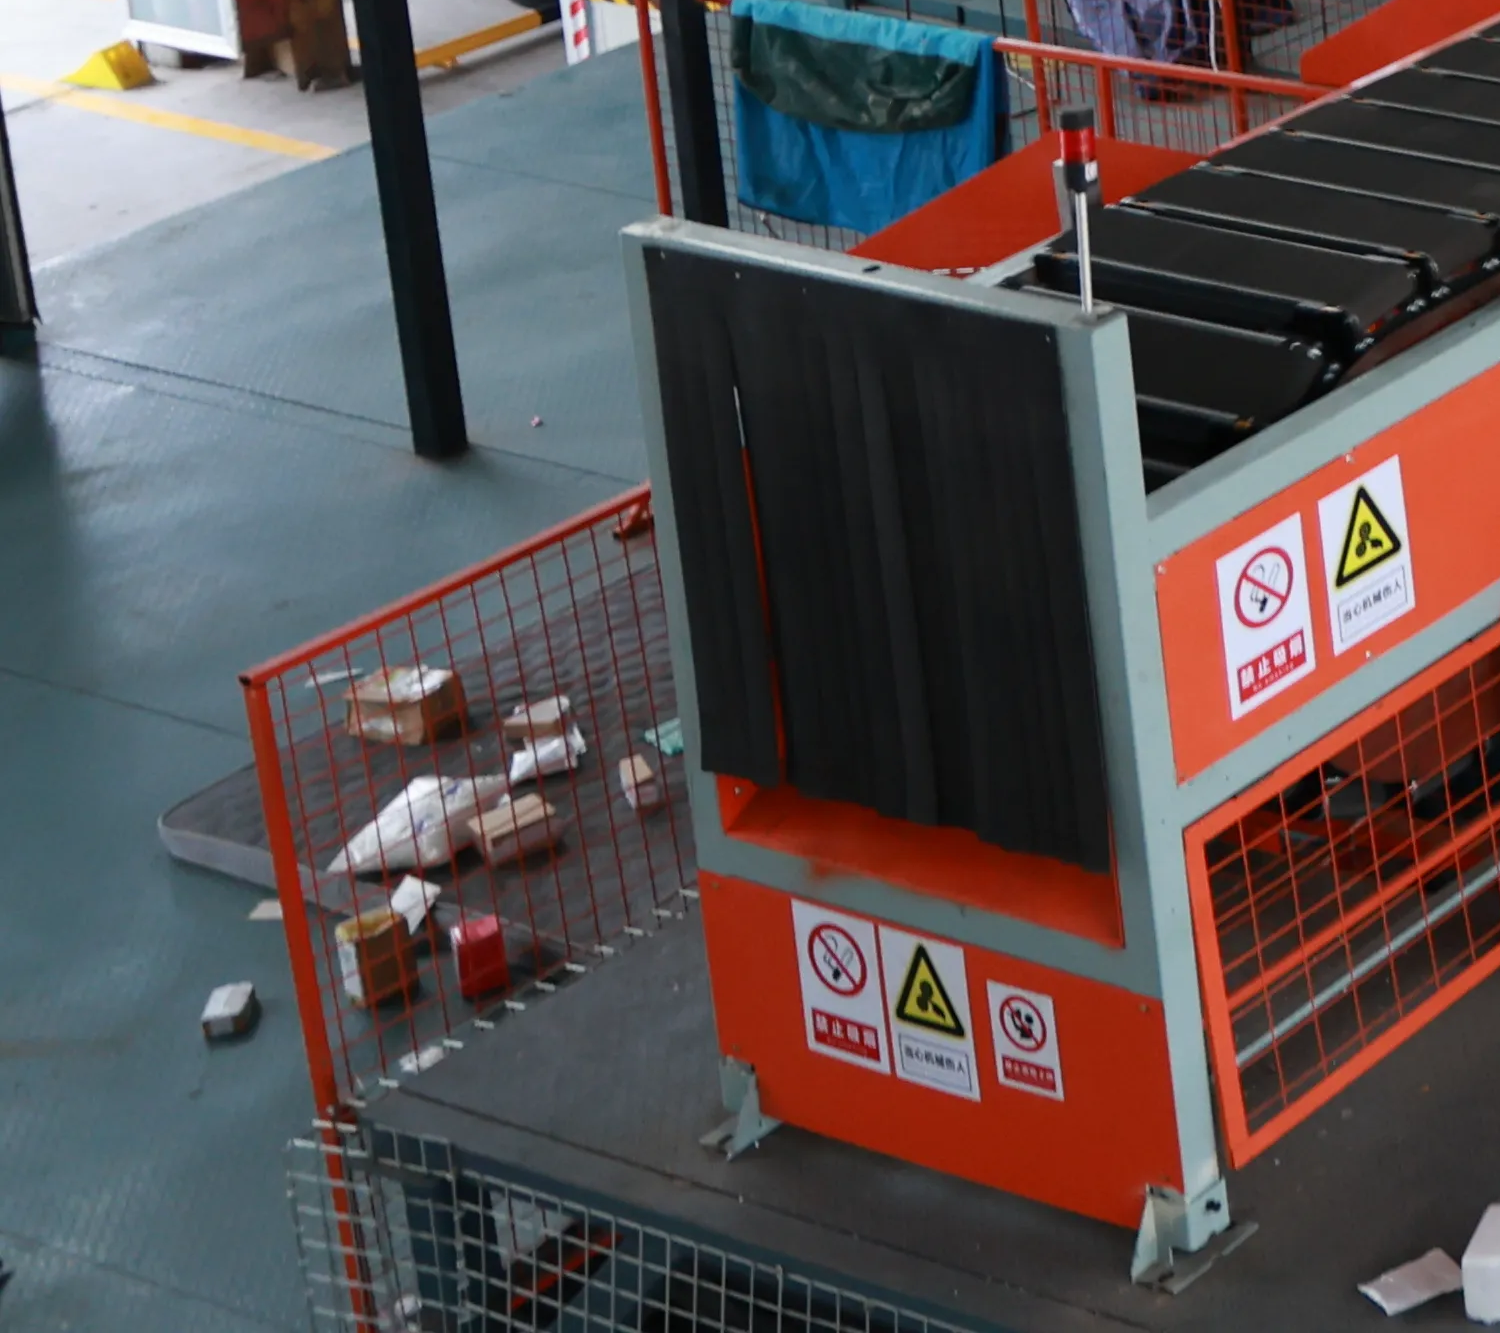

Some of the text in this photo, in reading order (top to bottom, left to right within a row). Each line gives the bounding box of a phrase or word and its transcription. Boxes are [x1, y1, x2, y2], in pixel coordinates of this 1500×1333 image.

[1342, 578, 1402, 623] 当心机械伤人
[1241, 632, 1304, 689] 禁止吸烟
[815, 1013, 876, 1050] 禁止吸烟
[904, 1044, 966, 1074] 当心机械伤人
